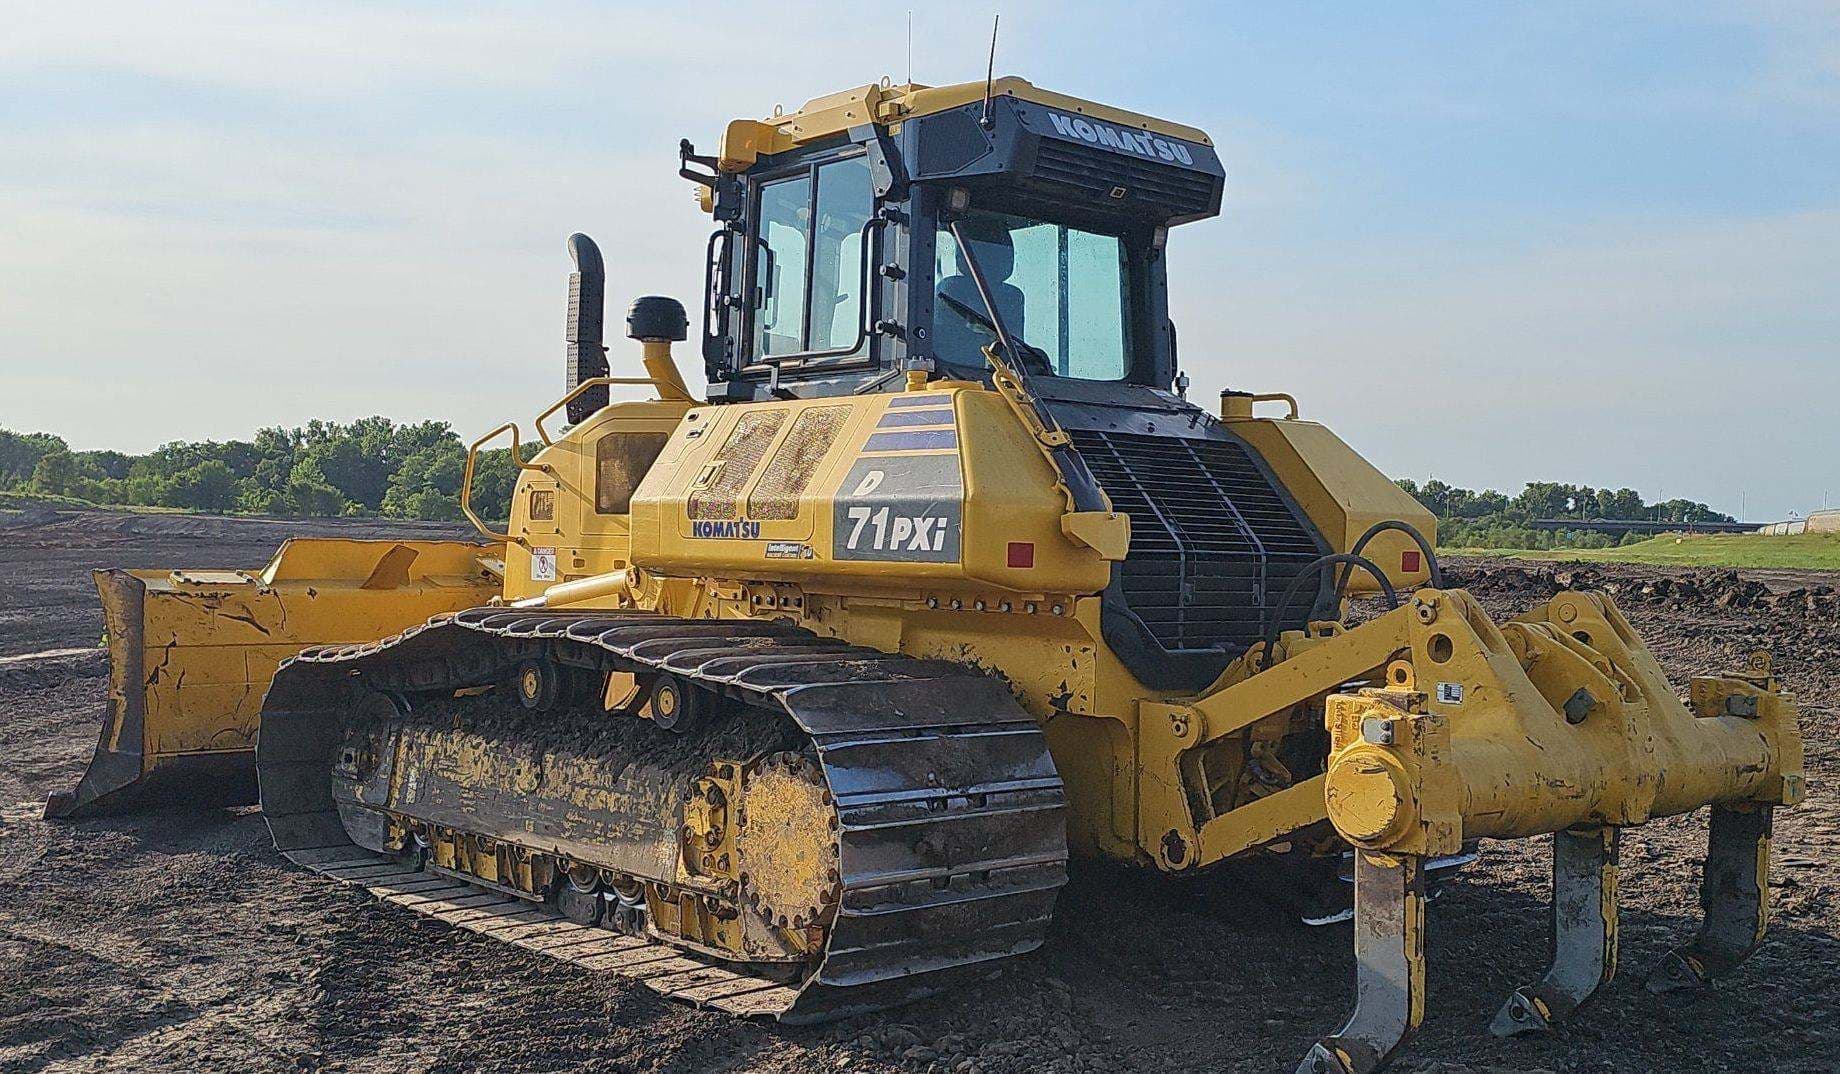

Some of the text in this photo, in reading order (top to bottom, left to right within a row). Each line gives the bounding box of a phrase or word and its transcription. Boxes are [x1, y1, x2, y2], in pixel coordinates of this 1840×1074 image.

[1048, 112, 1194, 166] KOMATSU
[852, 470, 885, 497] D
[692, 517, 761, 538] KOMATSU
[846, 506, 948, 551] 71PXi
